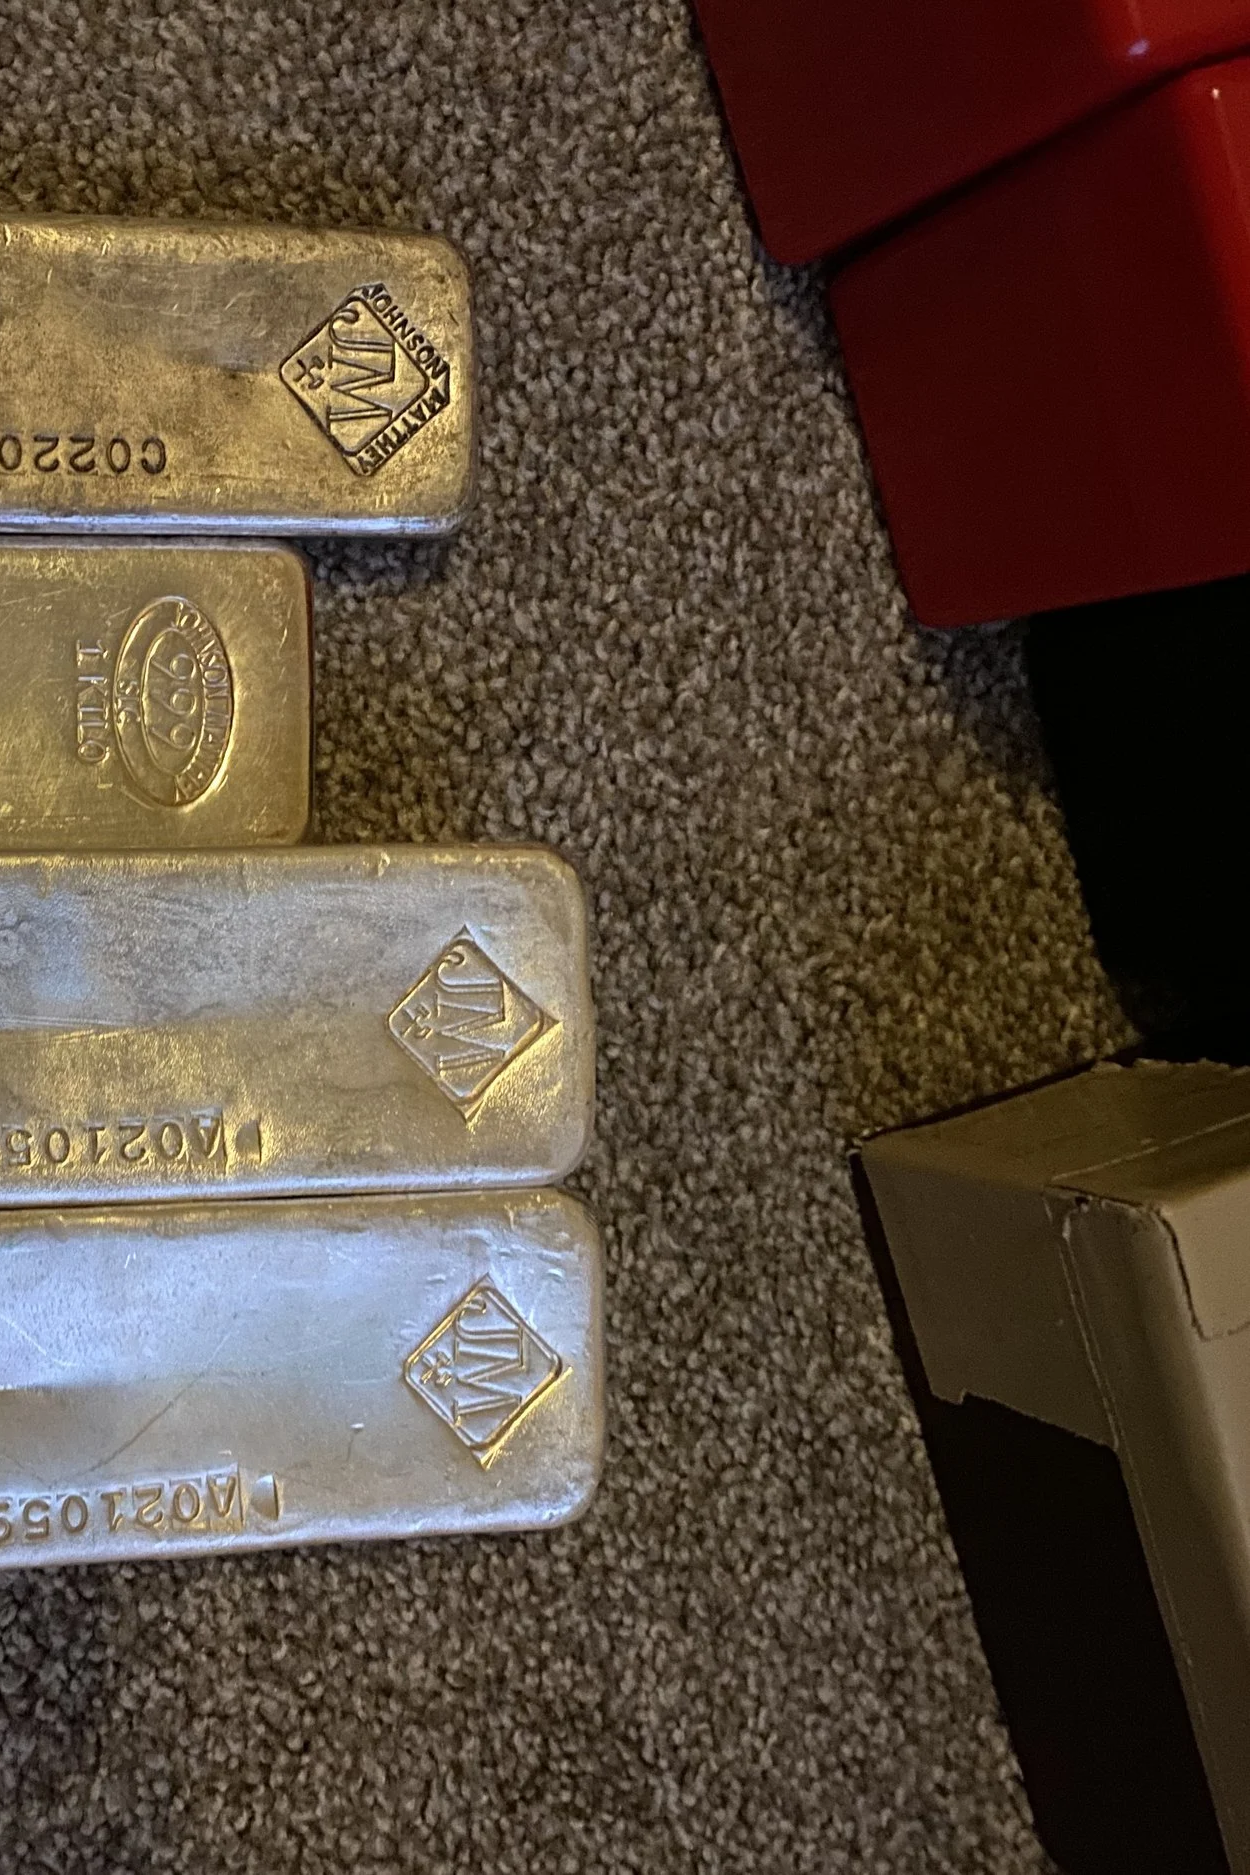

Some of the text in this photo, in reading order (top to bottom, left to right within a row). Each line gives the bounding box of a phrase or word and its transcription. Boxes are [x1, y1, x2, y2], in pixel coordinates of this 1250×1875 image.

[356, 282, 450, 475] JOHNSON MATTHEY
[76, 675, 110, 765] KILO
[152, 653, 198, 751] 999
